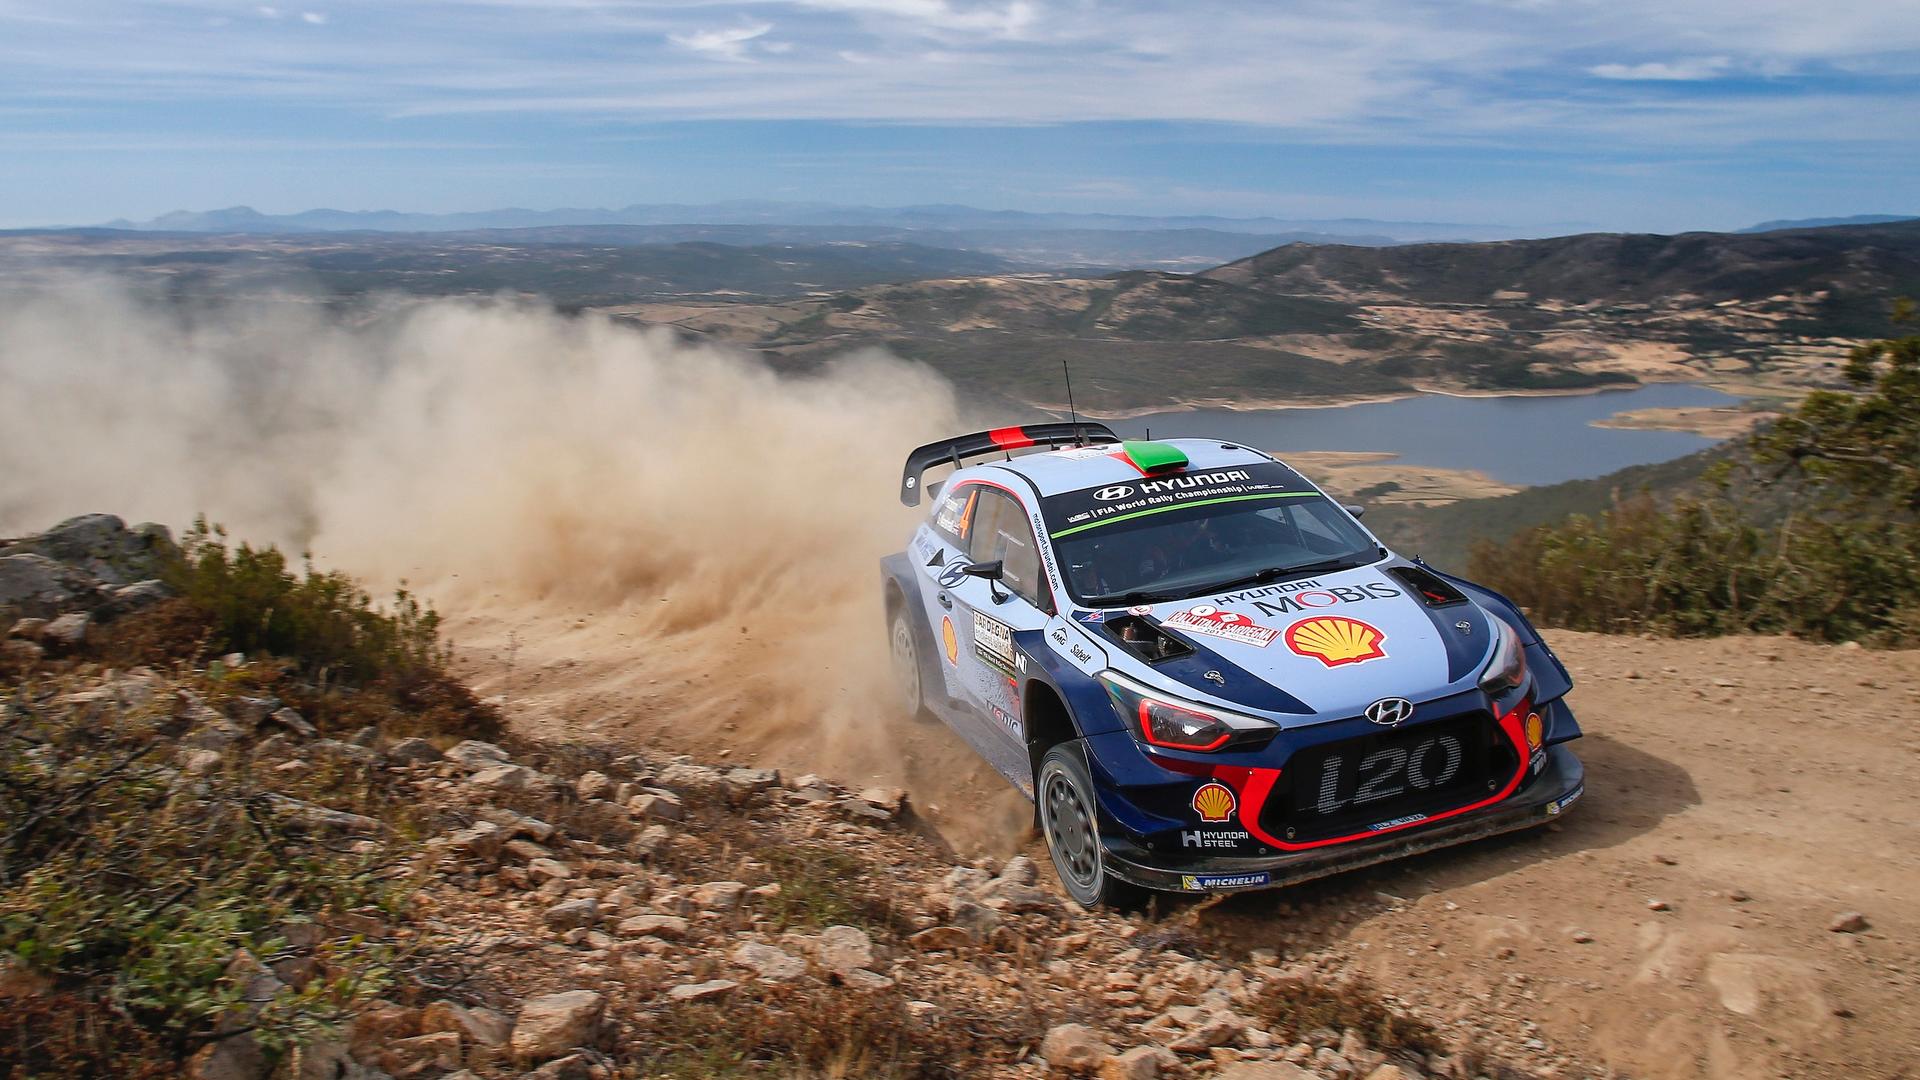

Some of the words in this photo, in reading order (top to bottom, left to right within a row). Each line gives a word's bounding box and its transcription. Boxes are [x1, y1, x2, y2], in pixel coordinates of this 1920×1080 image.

[1140, 470, 1250, 494] HYUNDAI
[1096, 506, 1116, 516] FIA
[1115, 499, 1147, 511] World
[1148, 494, 1174, 505] Rally
[1175, 484, 1243, 500] Championship
[959, 489, 977, 540] 4
[1032, 513, 1060, 592] motorsport.hyundai.com
[1214, 580, 1323, 606] HYUNDAI
[1251, 582, 1401, 618] MOBIS
[974, 613, 1010, 641] SARDEGNA
[1168, 611, 1198, 625] RALLY
[1196, 617, 1224, 630] ITALIA
[1225, 623, 1276, 641] SARDEGNA
[1070, 643, 1092, 665] Sabelt
[1202, 831, 1249, 840] HYUNDAI
[1204, 840, 1238, 848] STEEL
[1204, 876, 1265, 887] MICHELIN
